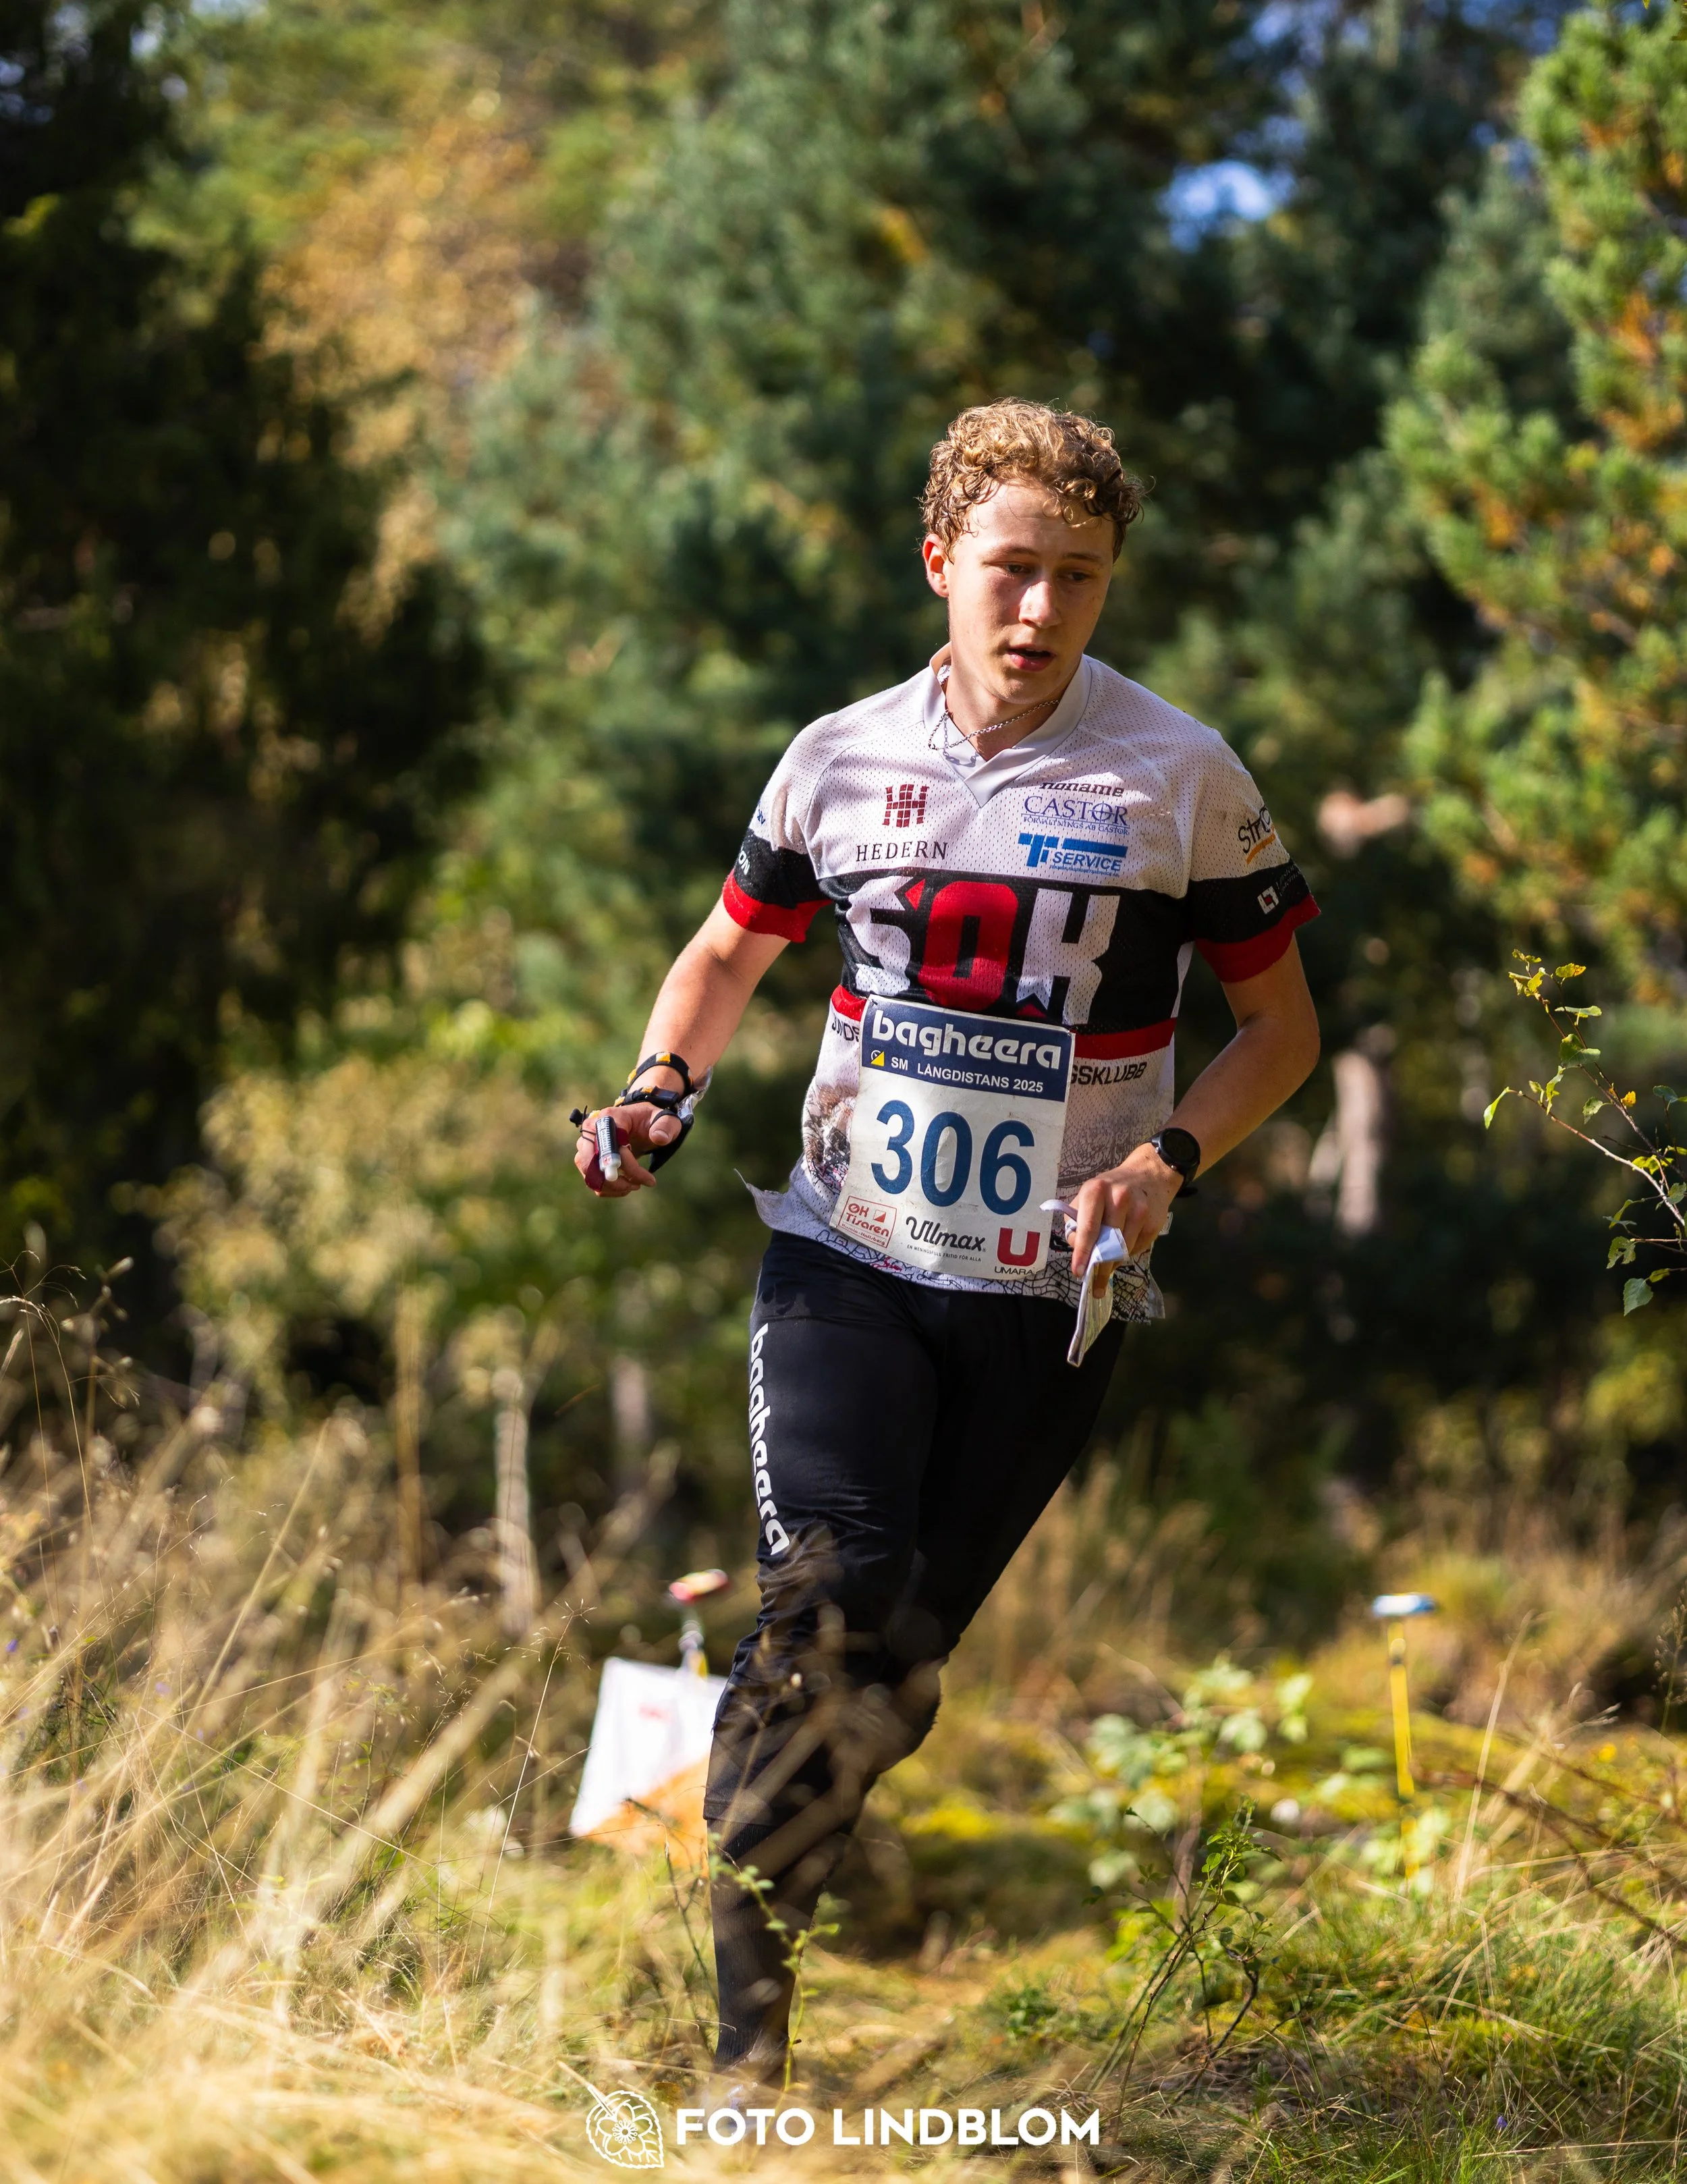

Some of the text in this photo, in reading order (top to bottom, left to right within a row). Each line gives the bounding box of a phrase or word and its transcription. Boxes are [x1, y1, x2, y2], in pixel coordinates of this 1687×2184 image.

[1040, 782, 1125, 797] noname
[1024, 795, 1130, 826] CASTOR
[856, 840, 948, 861] HEDERN
[1052, 851, 1123, 871] SERVICE
[846, 875, 1121, 1025] SOK
[872, 1010, 1061, 1070] bagheera
[891, 1056, 1043, 1093] SM LÅNGDISTANS 2025
[870, 1099, 1035, 1216] 306
[846, 1212, 889, 1237] Tisaren
[906, 1216, 986, 1252] Ullmax
[994, 1265, 1033, 1276] UMARA
